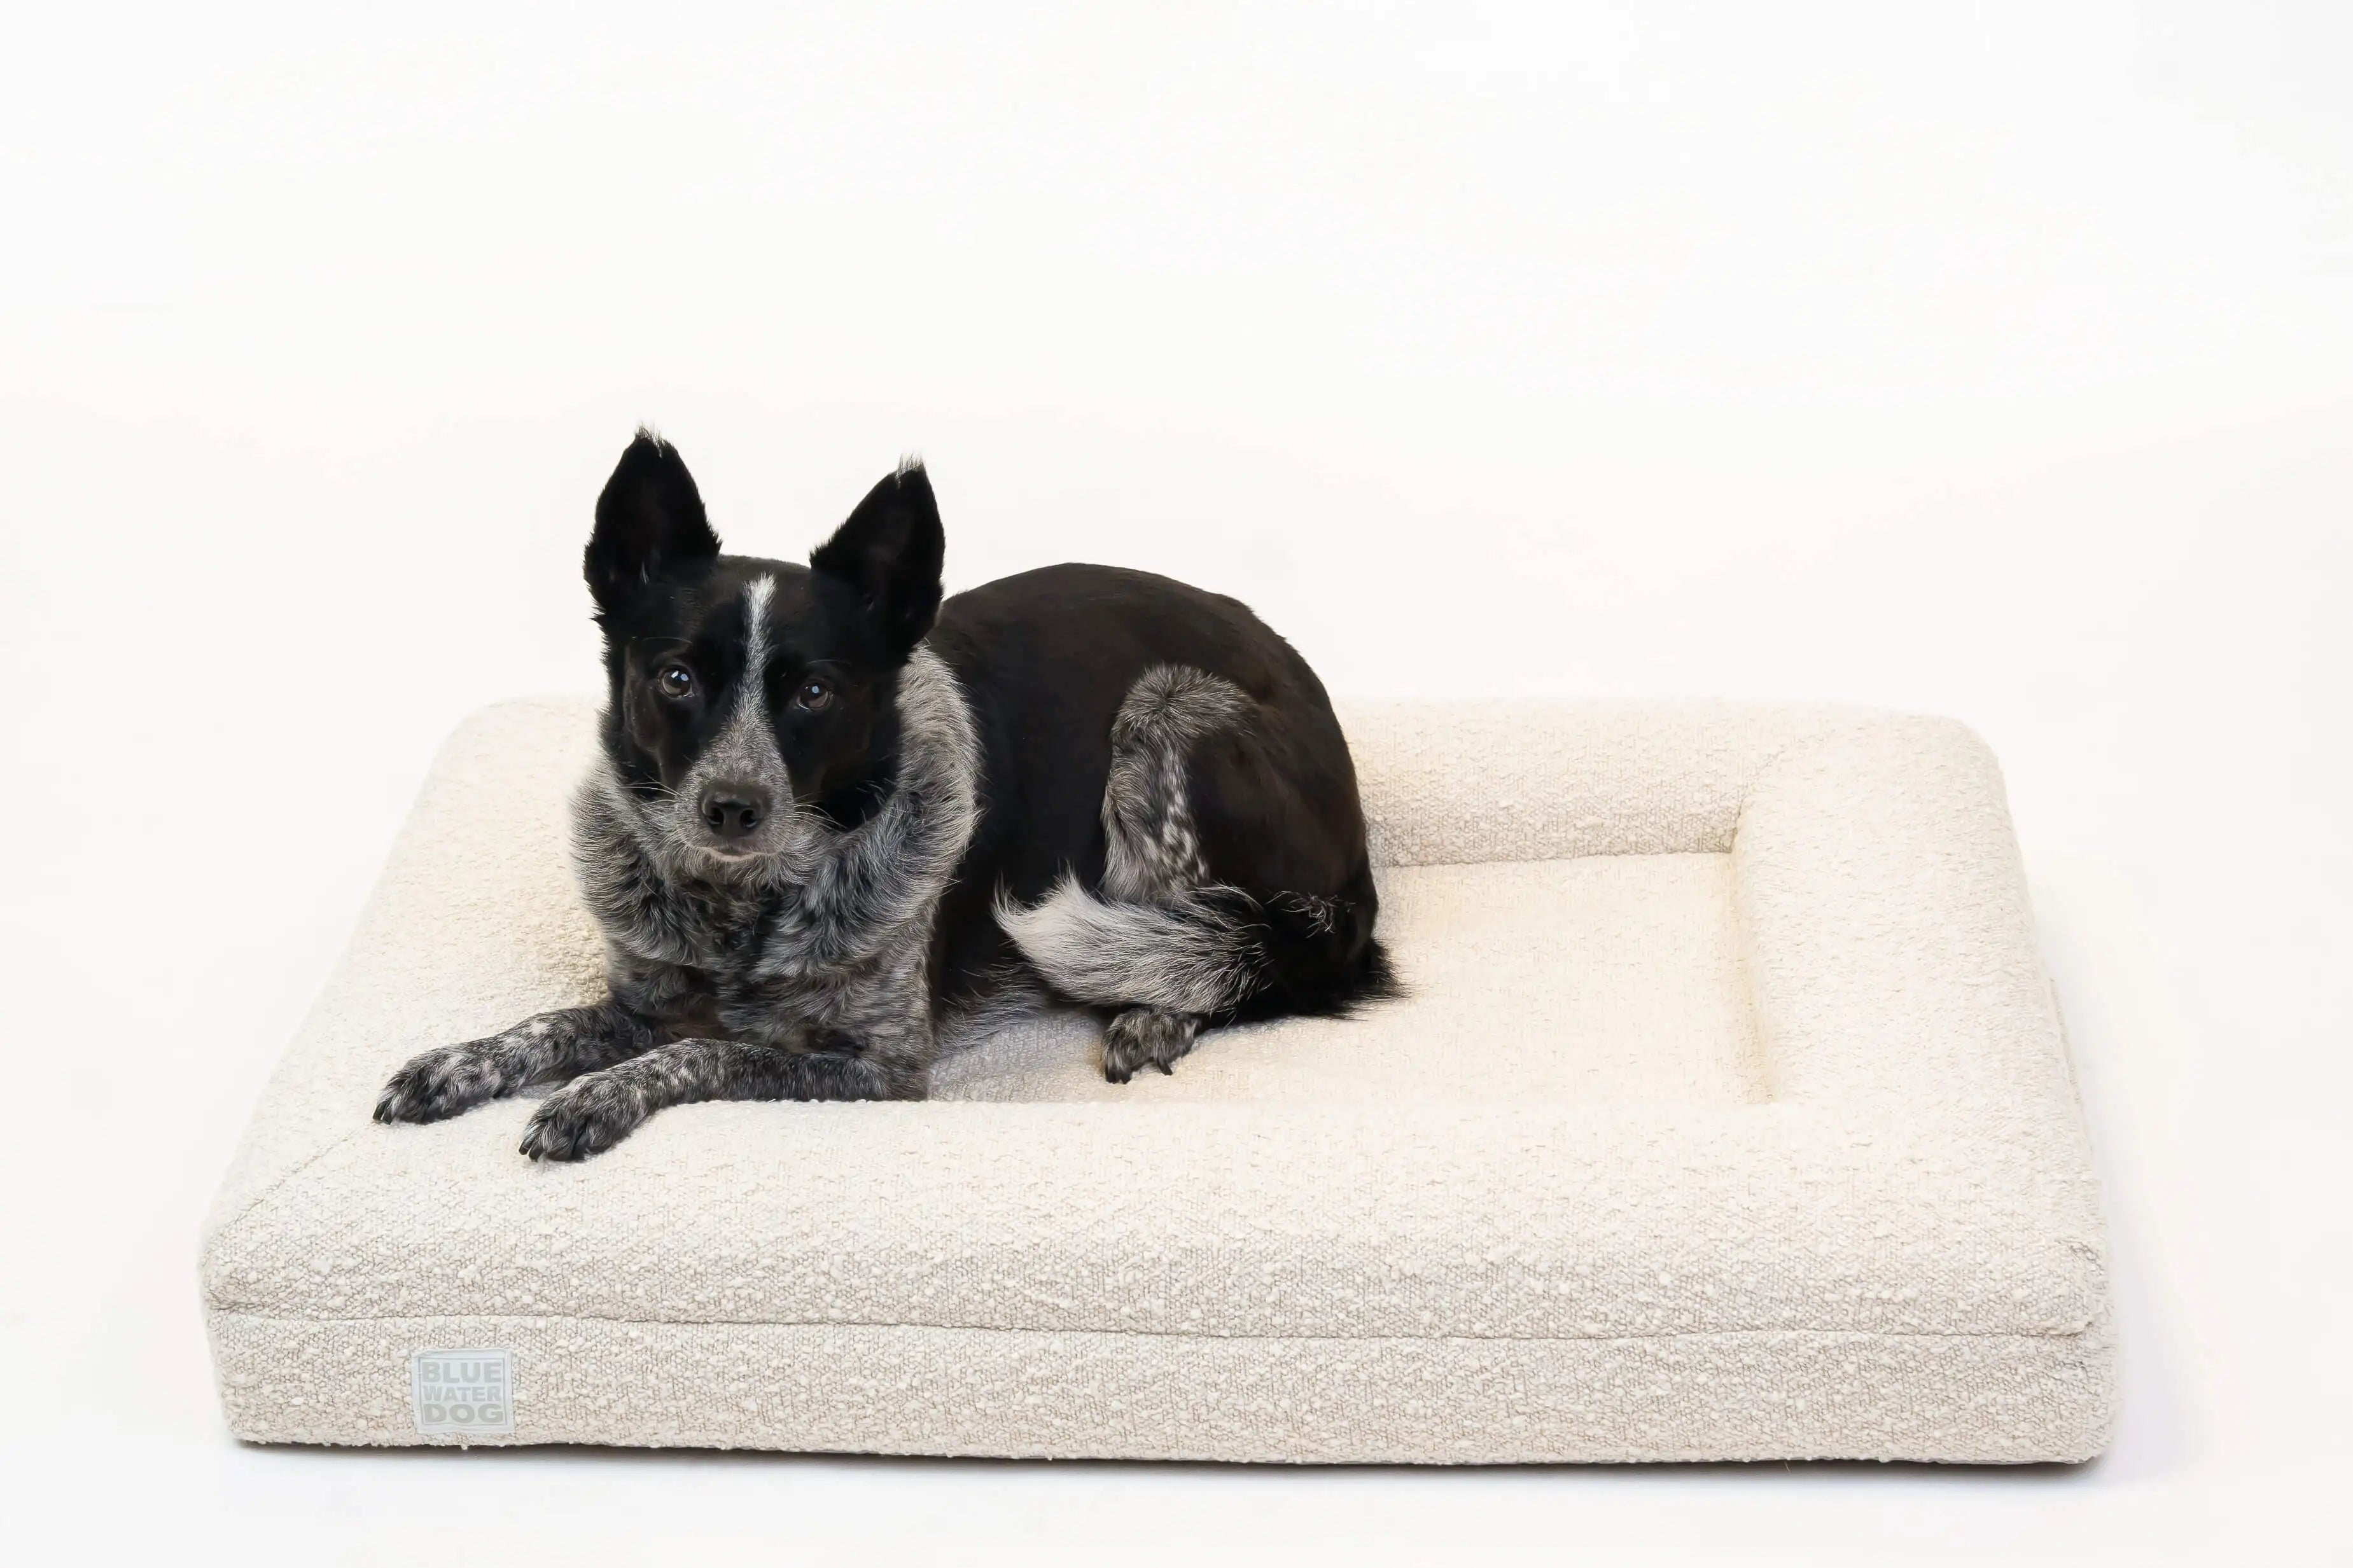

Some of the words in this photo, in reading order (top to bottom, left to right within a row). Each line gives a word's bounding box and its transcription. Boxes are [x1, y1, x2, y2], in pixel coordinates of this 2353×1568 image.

[422, 1362, 502, 1383] BLUE
[422, 1385, 501, 1402] WATER
[423, 1403, 503, 1424] DOG
